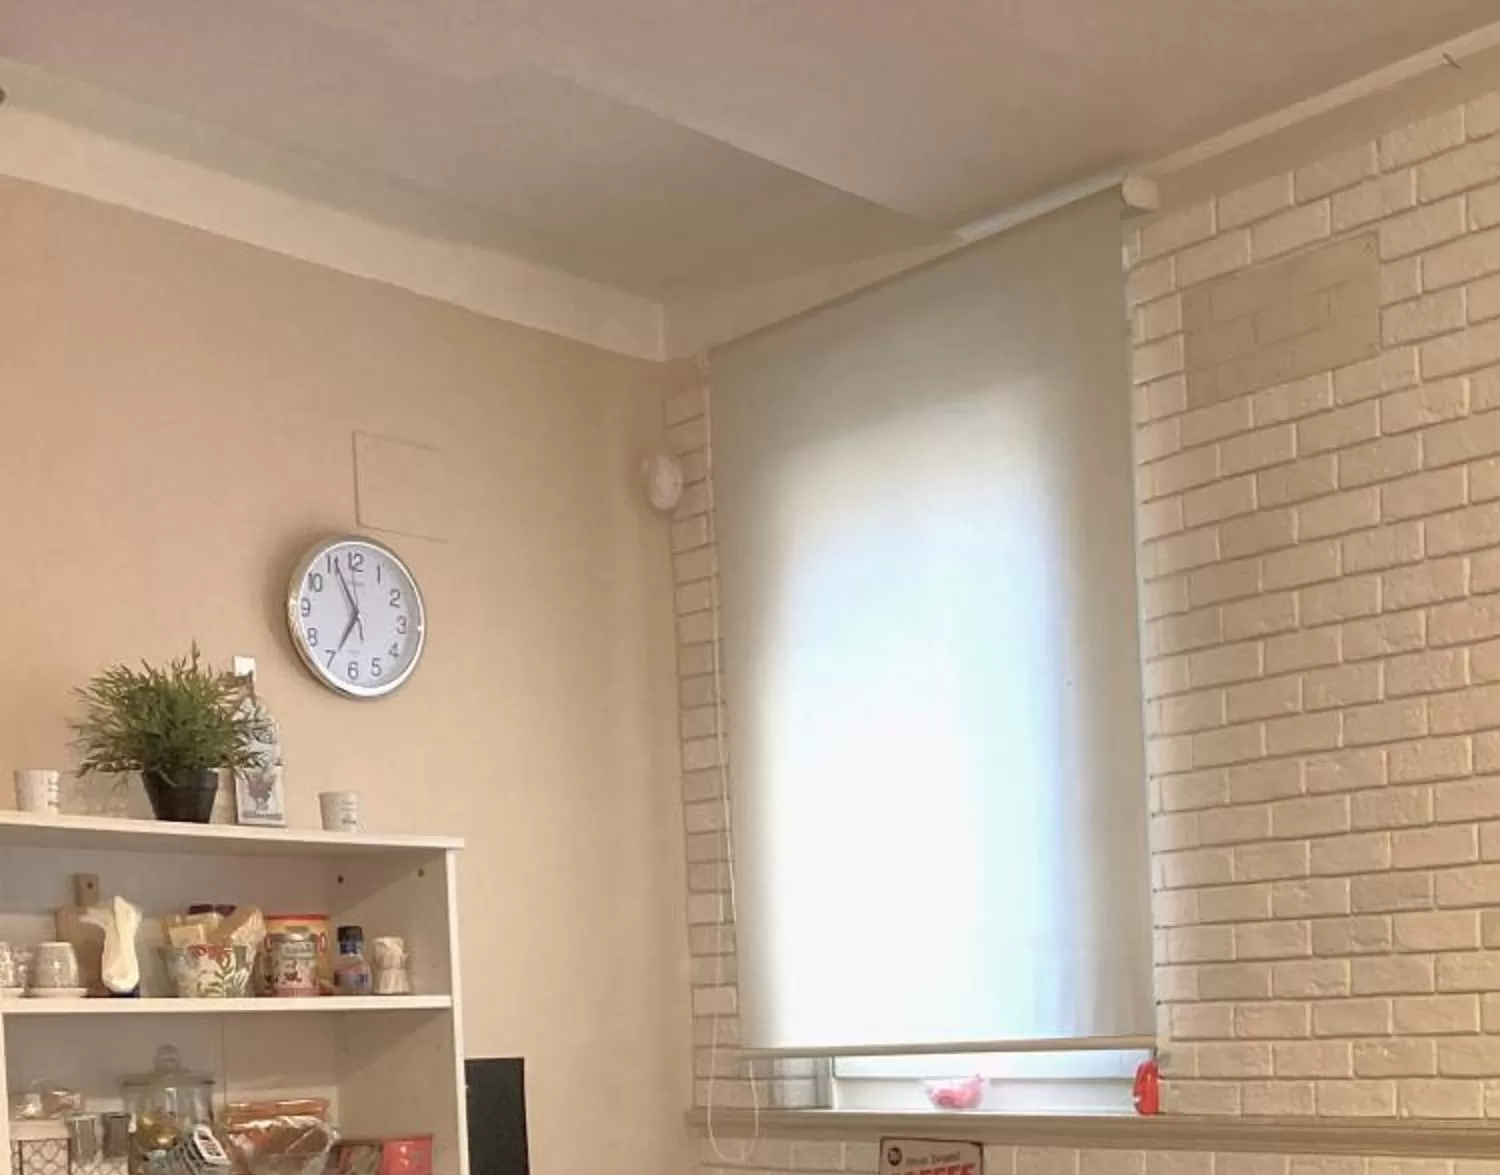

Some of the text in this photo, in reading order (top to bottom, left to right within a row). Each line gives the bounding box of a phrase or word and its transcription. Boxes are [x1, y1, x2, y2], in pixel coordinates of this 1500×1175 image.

[348, 552, 364, 573] 12
[308, 572, 323, 592] 10
[301, 598, 311, 617] 9
[389, 588, 401, 608] 2
[396, 615, 407, 634] 3
[307, 627, 318, 646] 8
[324, 649, 337, 669] 7
[388, 642, 399, 658] 4
[347, 661, 359, 680] 6
[371, 657, 382, 676] 5
